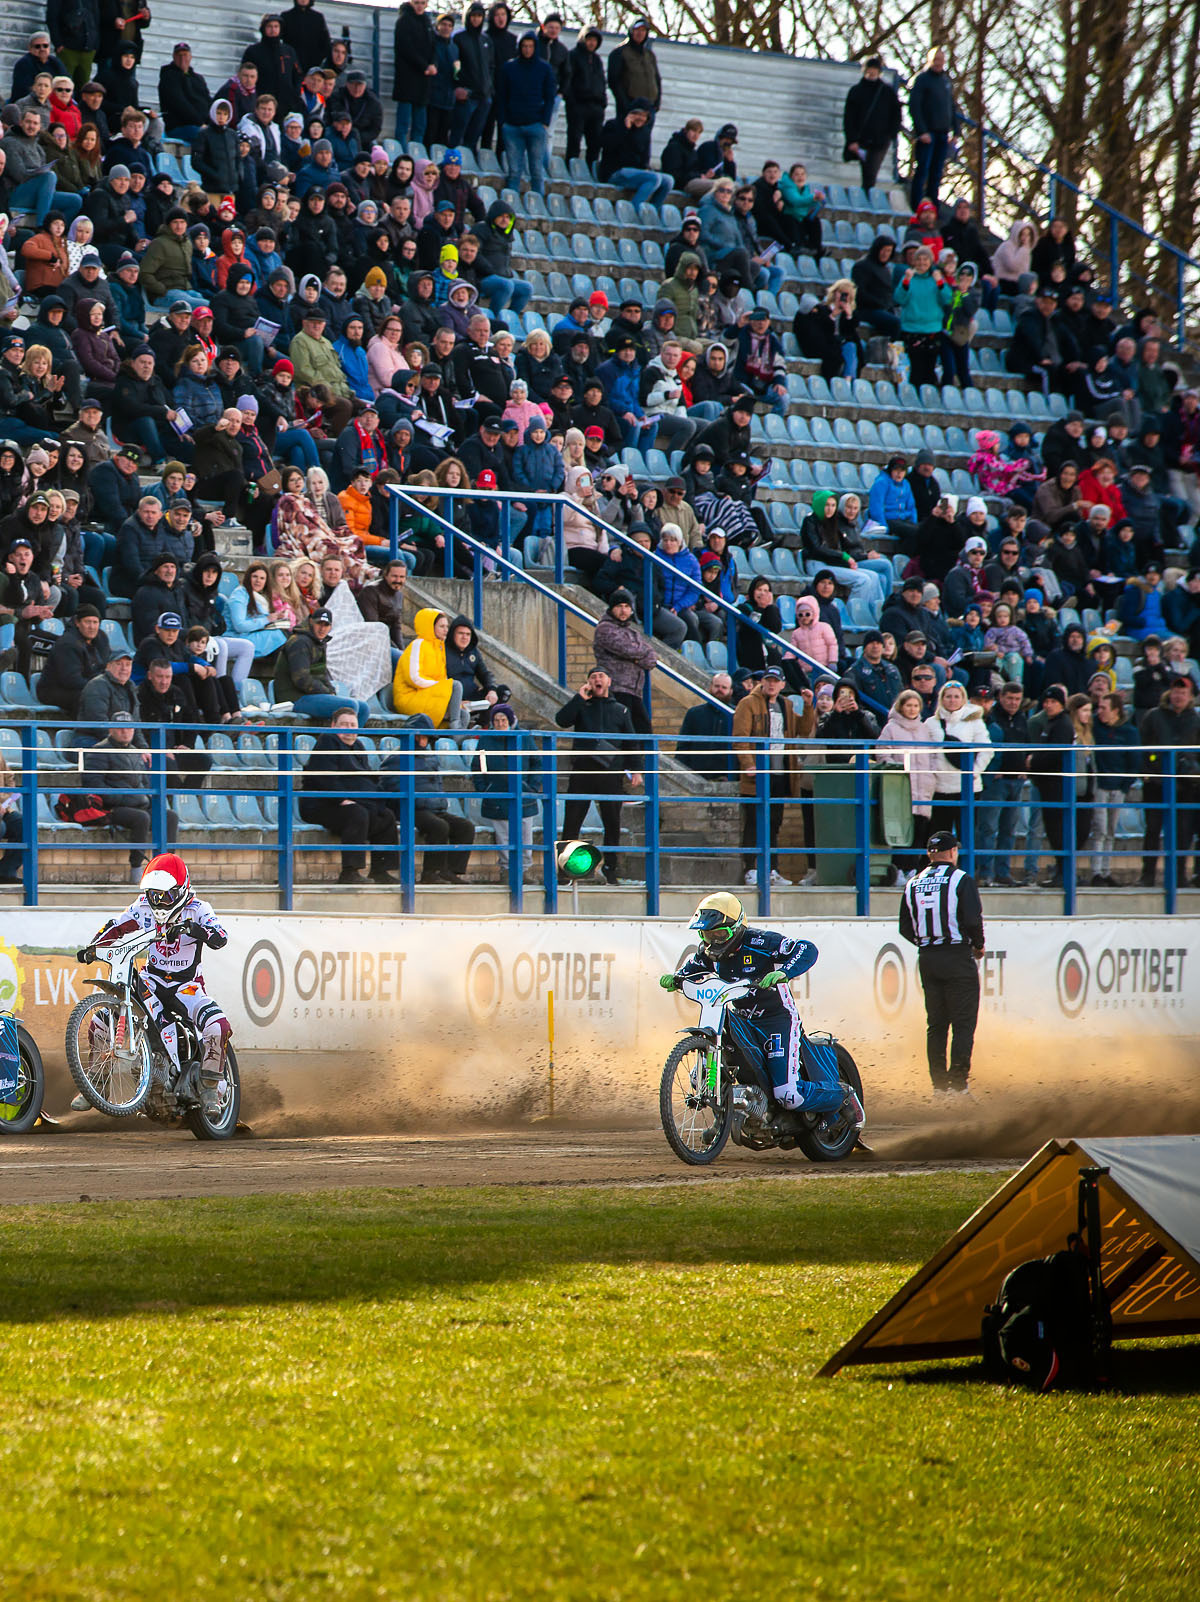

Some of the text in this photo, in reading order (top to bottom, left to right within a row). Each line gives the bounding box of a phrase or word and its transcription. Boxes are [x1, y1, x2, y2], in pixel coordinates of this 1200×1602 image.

[114, 943, 140, 956] OPTIBET
[159, 958, 189, 967] OPTIBET
[34, 968, 81, 1005] LVK
[294, 949, 407, 1001] OPTIBET
[512, 951, 616, 1001] OPTIBET
[1096, 948, 1188, 994] OPTIBET
